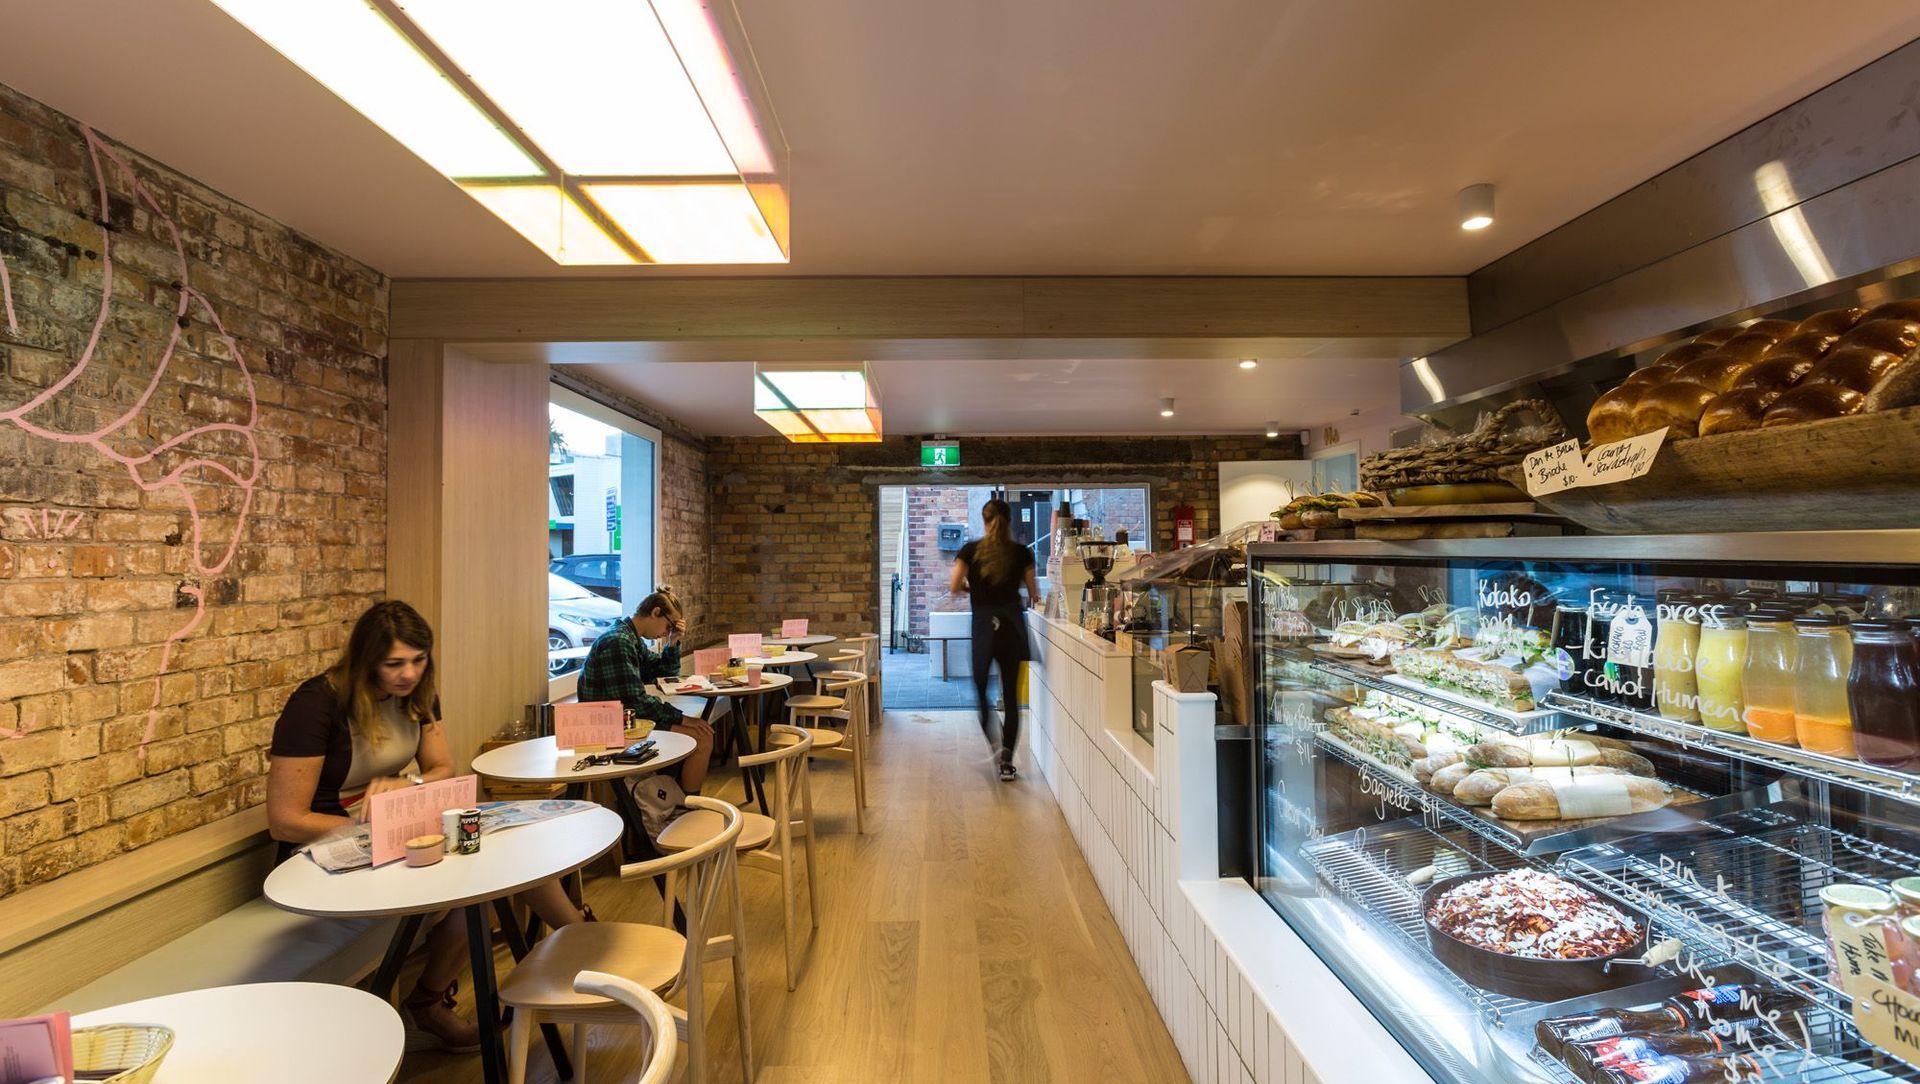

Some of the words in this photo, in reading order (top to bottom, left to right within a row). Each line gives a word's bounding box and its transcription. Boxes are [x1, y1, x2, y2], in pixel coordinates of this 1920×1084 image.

[1655, 602, 1727, 631] press
[1357, 762, 1414, 822] Baguette
[1839, 940, 1863, 976] Home
[1858, 931, 1888, 965] Take
